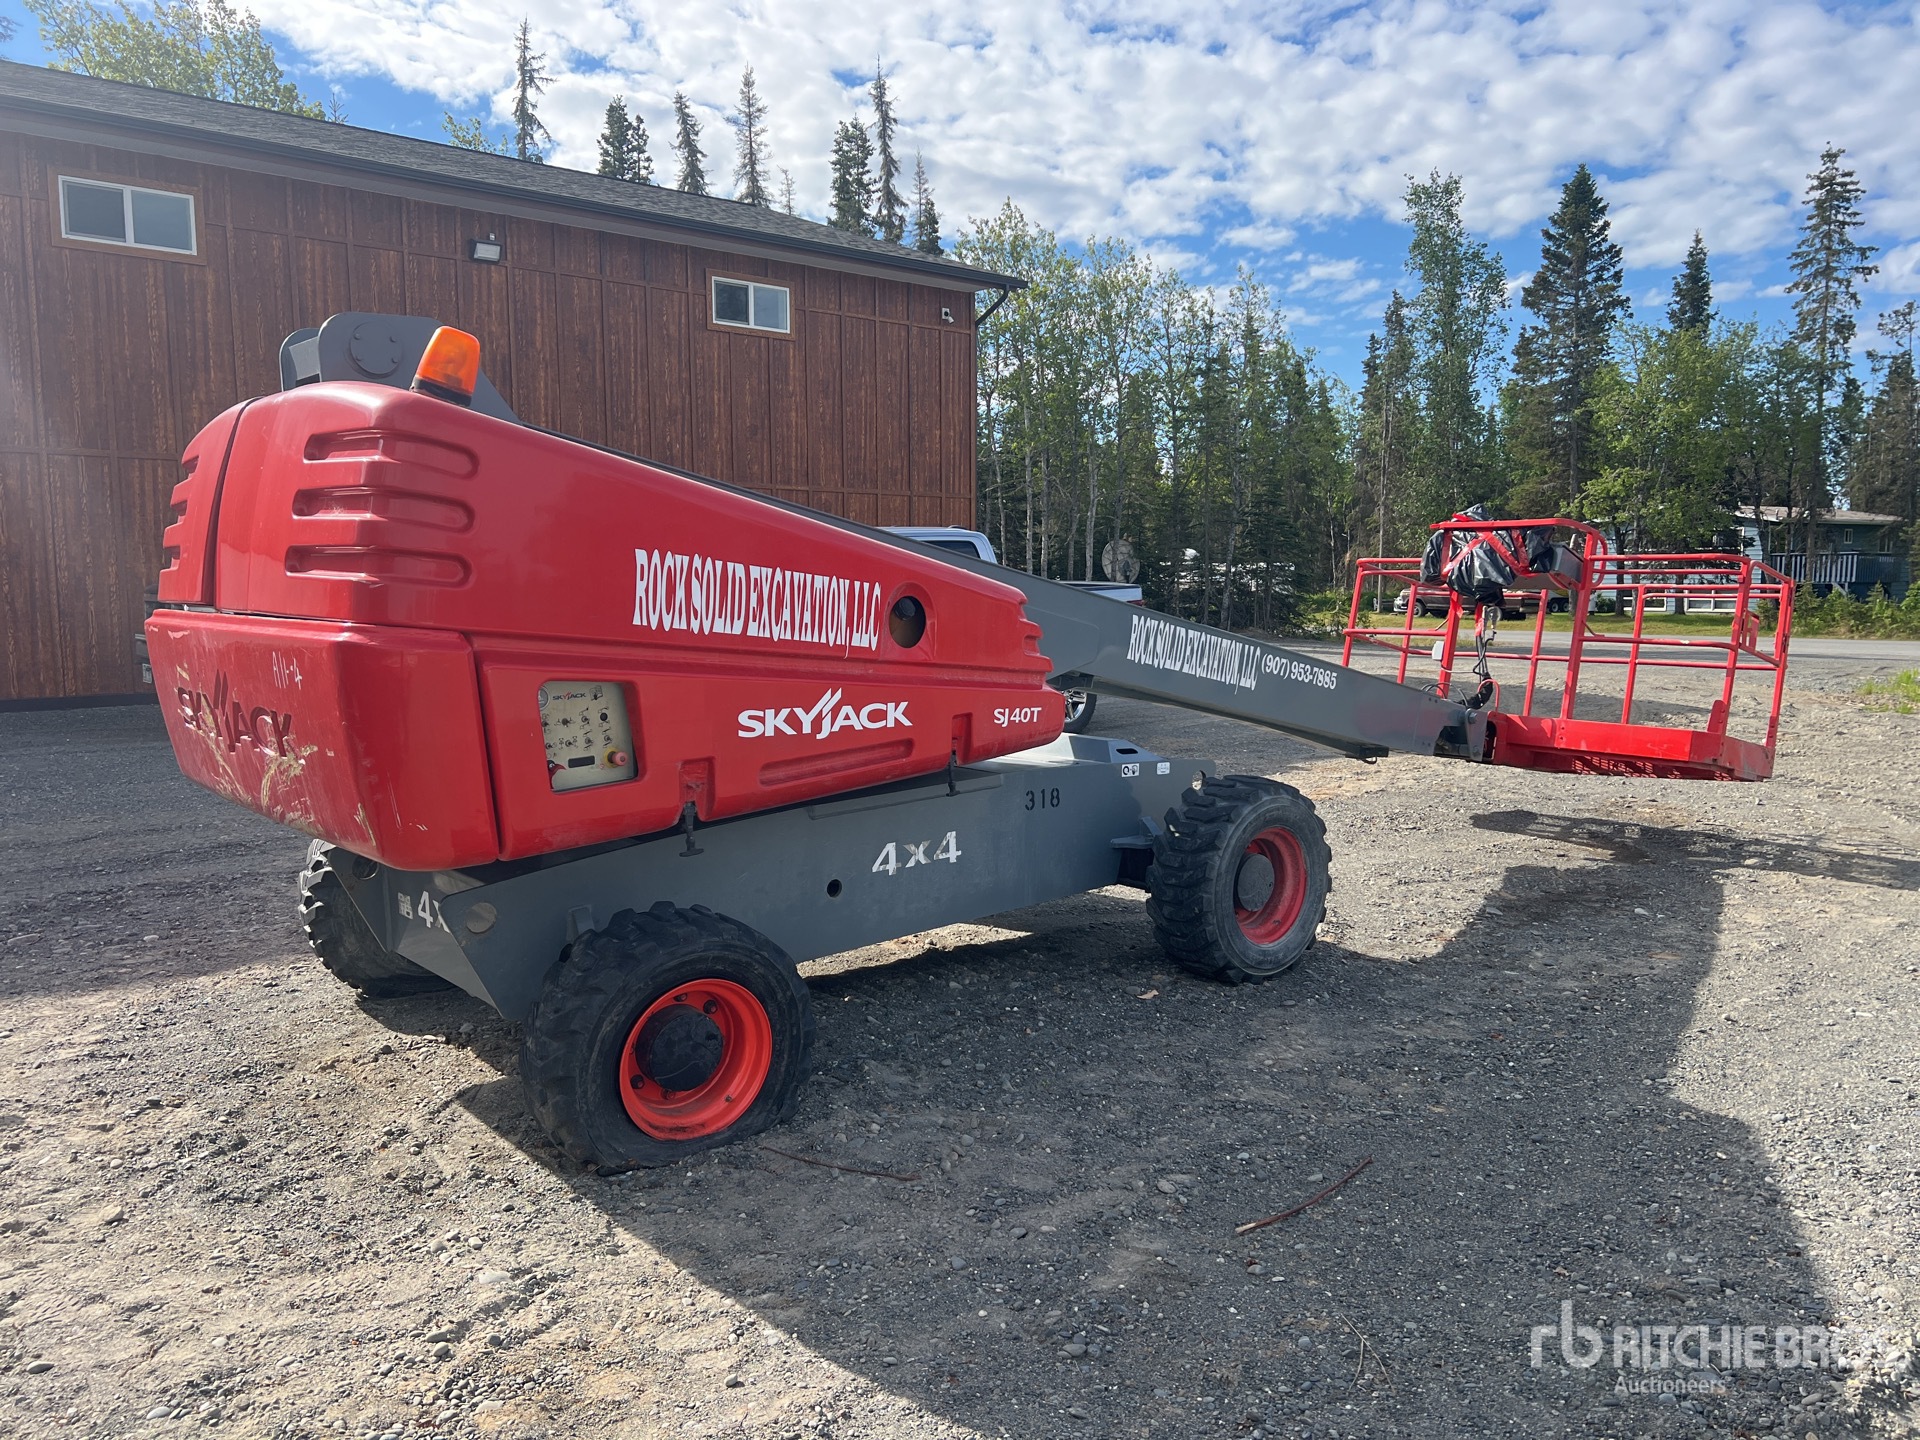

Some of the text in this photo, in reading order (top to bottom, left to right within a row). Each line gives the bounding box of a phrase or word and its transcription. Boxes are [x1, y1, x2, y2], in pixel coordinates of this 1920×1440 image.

[632, 548, 882, 659] ROCK SOLID EXCAVATION, LLC
[1127, 614, 1338, 695] ROCK SOLID EXCAVATION, LLC (907) 953-7885
[177, 668, 300, 760] SKYJACK
[552, 691, 587, 700] SKYJACK
[737, 687, 913, 740] SKYJACK
[993, 706, 1042, 728] SJ40T
[1024, 787, 1061, 811] 318
